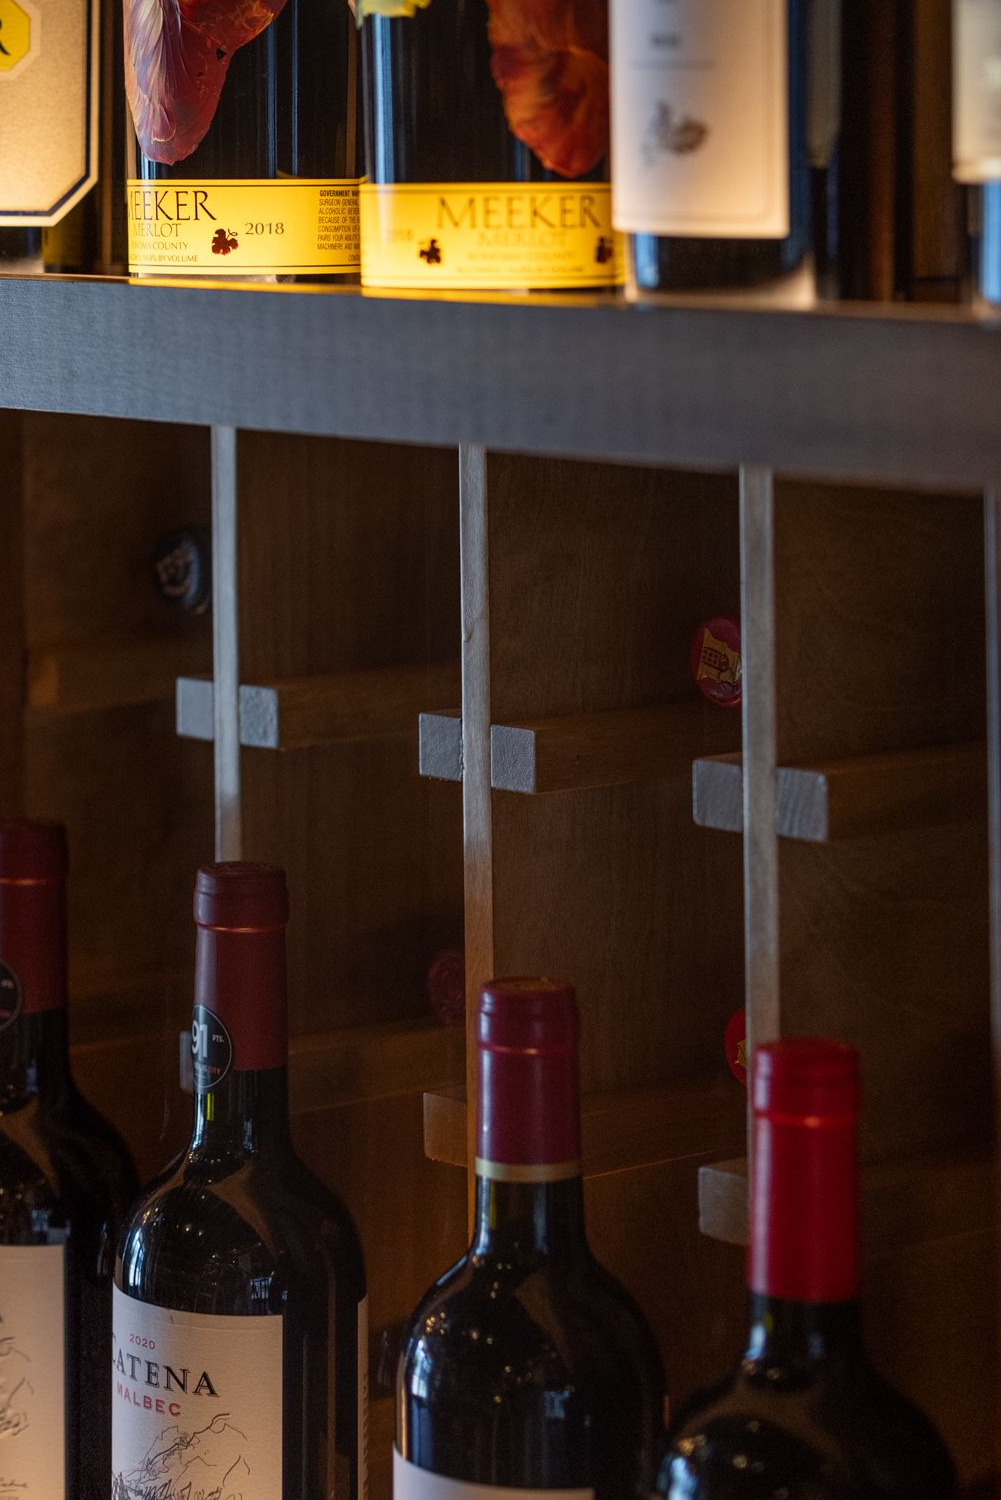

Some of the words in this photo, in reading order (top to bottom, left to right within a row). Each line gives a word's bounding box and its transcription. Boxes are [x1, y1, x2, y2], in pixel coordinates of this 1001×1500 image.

[319, 189, 351, 197] GOVERNMENT
[437, 194, 603, 231] MEEKER
[133, 222, 182, 238] MERLOT
[244, 221, 285, 236] 2018
[152, 241, 189, 251] COUNTY
[167, 254, 199, 264] VOLUME
[191, 1018, 209, 1059] 91
[129, 1333, 157, 1350] 2020
[116, 1380, 182, 1417] MALBEC
